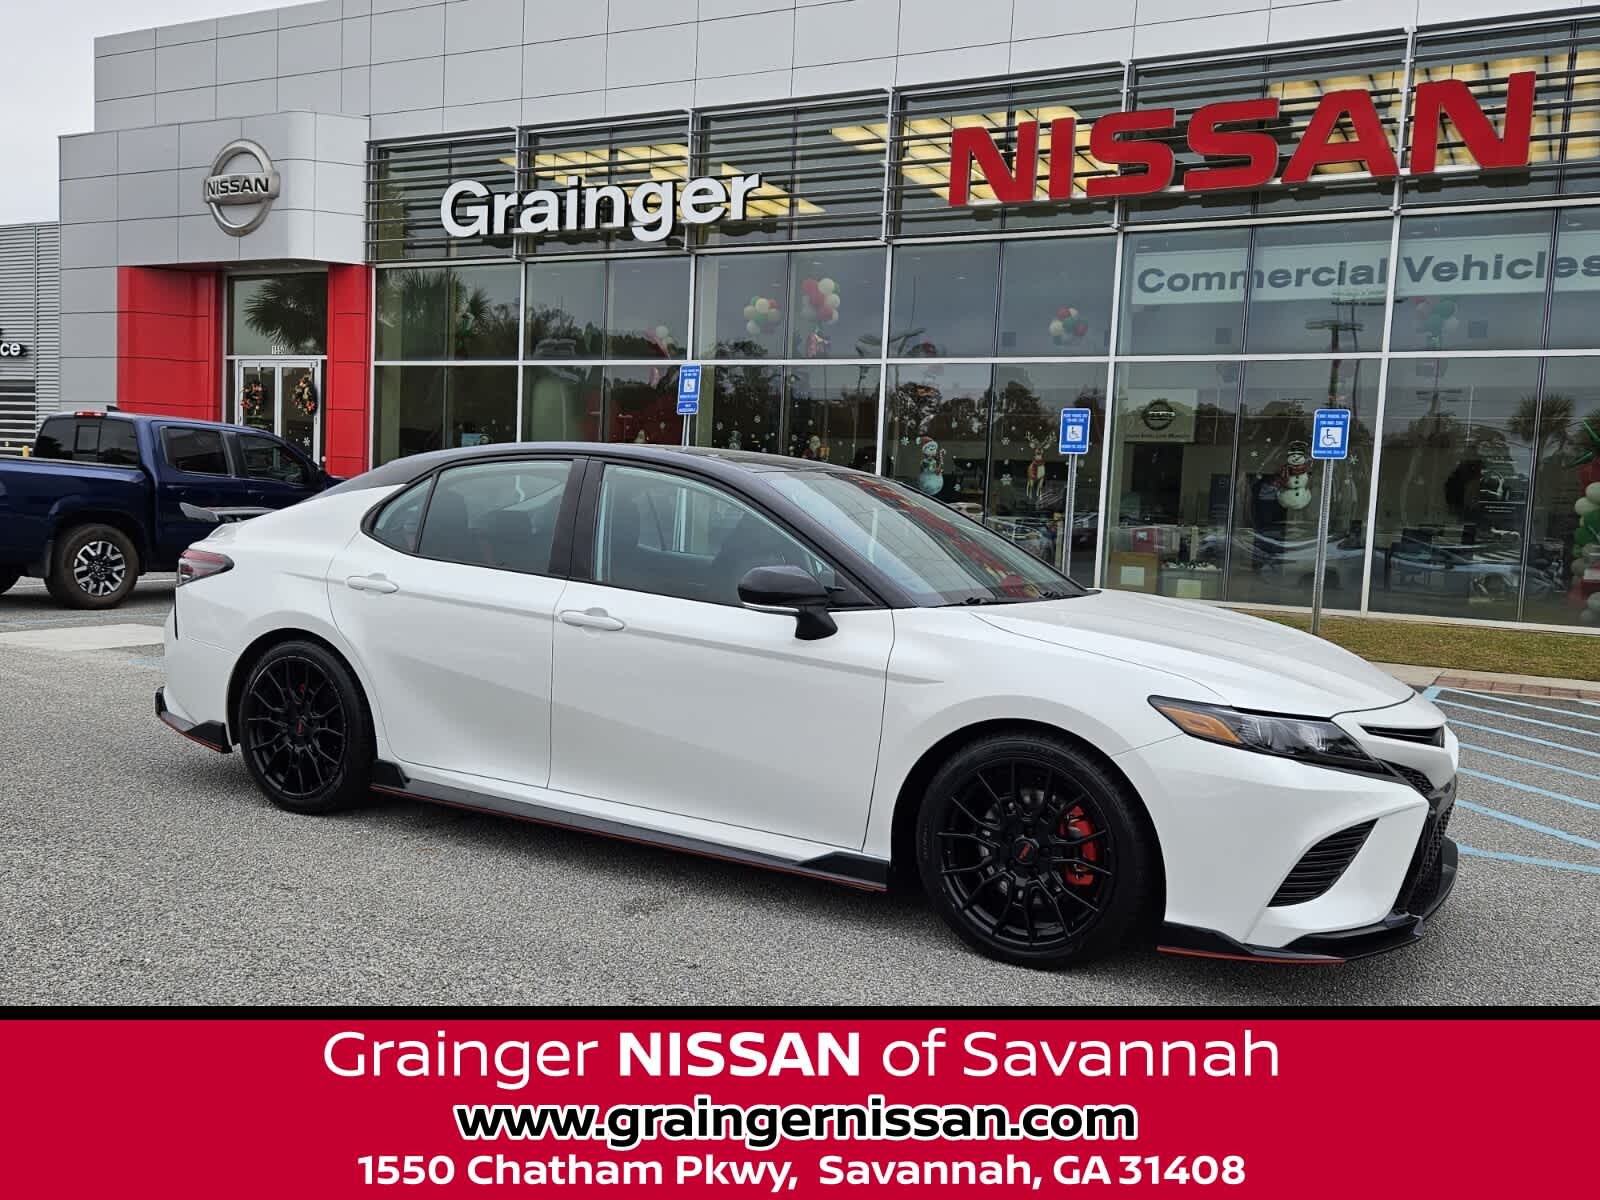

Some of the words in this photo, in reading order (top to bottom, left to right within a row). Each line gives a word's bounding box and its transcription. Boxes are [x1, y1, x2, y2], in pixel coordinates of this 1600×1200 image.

[949, 71, 1536, 206] NISSAN
[207, 177, 269, 196] NISSAN
[441, 173, 761, 242] Grainger
[1138, 258, 1387, 293] Commercial
[1403, 251, 1600, 282] Vehicles
